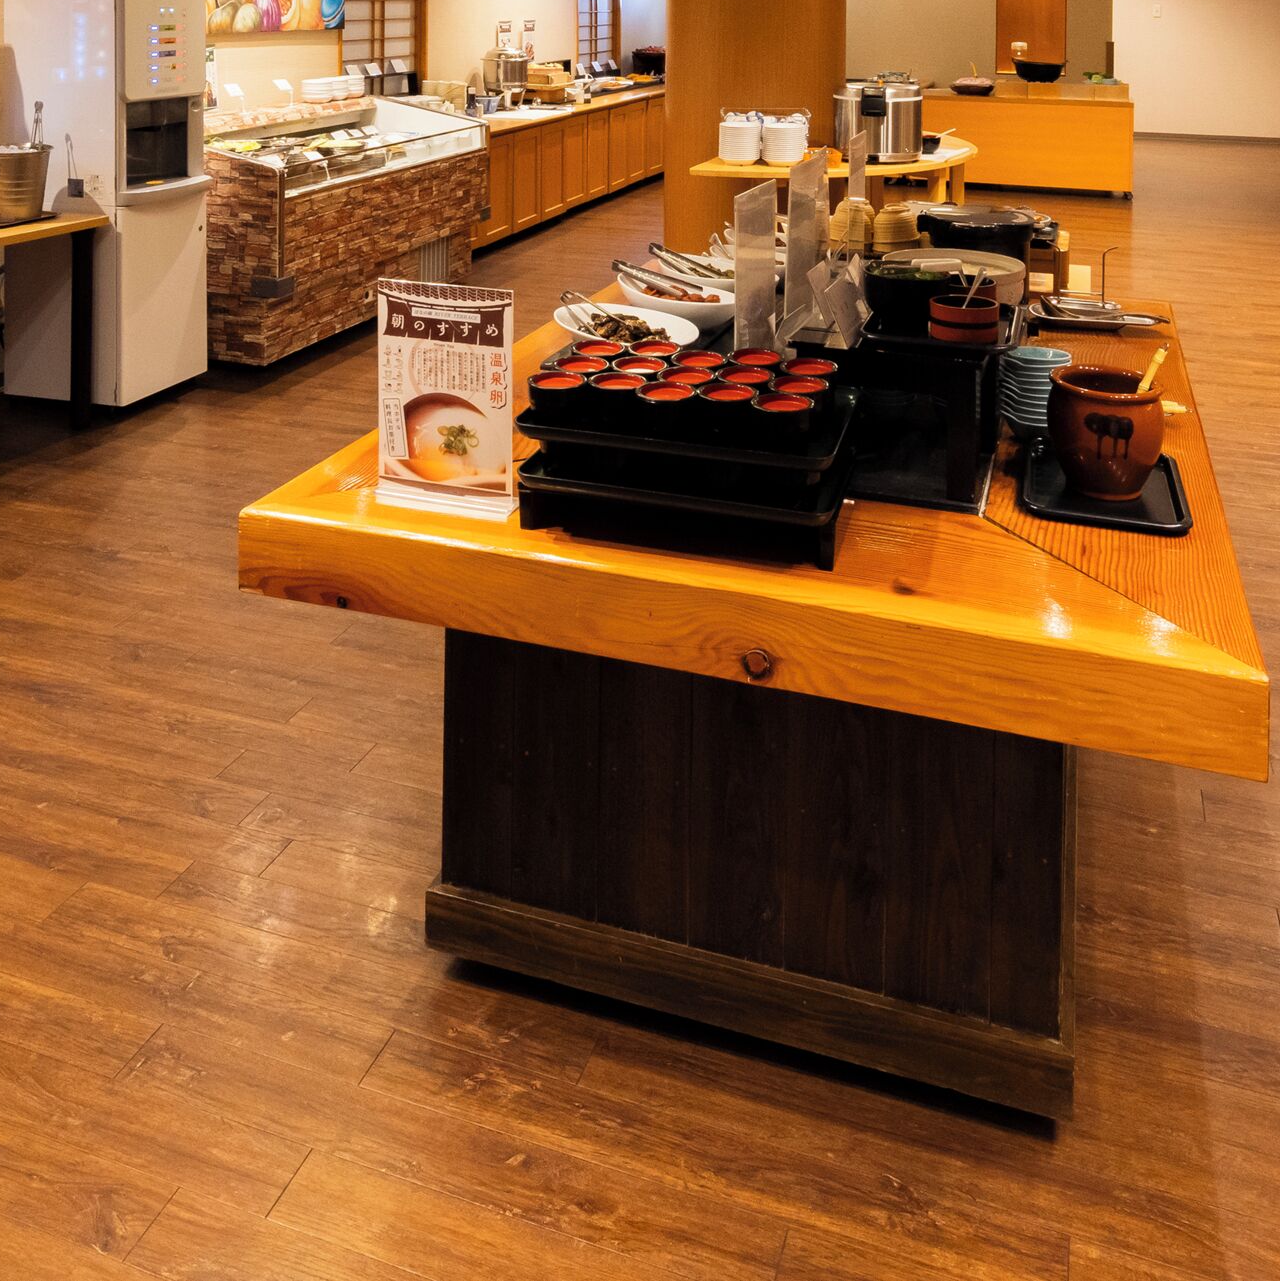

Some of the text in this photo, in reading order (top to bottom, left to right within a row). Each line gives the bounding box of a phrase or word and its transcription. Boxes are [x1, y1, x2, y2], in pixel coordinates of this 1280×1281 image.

[391, 313, 499, 337] 朝のすすめ
[489, 351, 504, 405] 温泉卵
